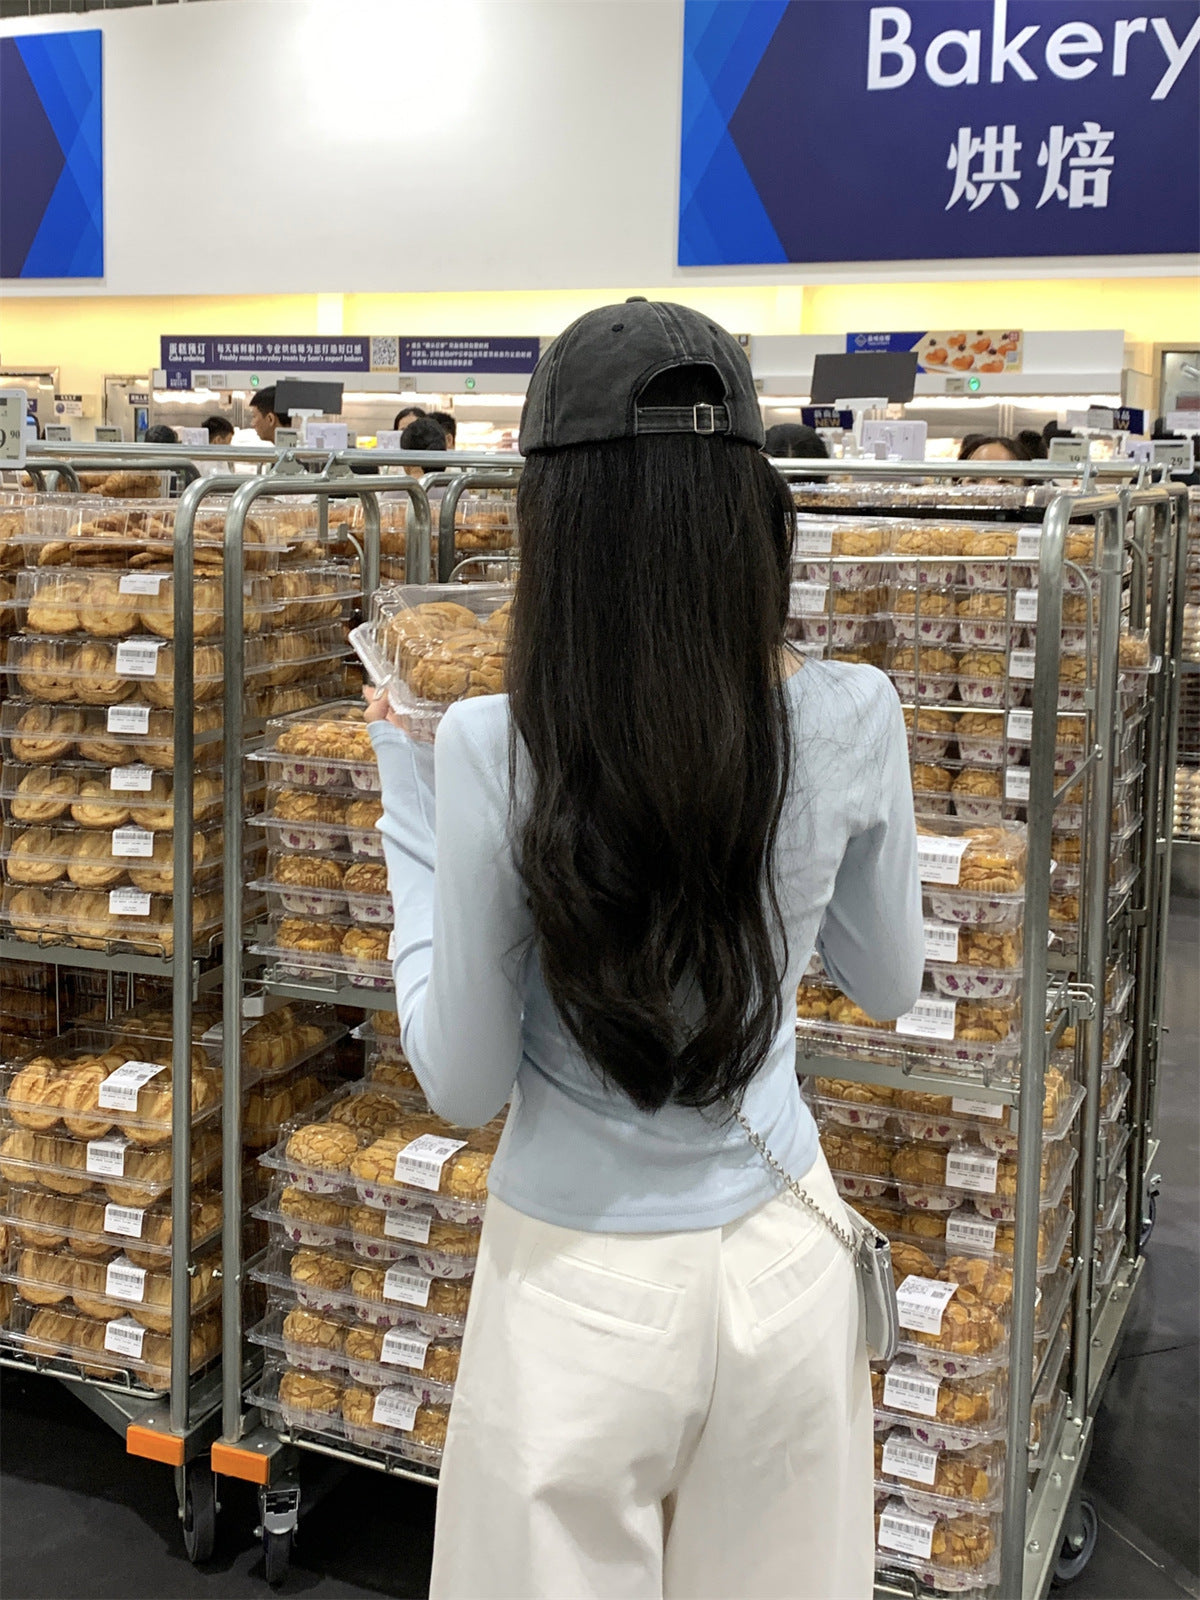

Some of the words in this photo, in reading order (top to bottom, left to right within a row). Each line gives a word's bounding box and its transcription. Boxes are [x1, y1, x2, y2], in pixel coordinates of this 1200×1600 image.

[867, 0, 1200, 101] Bakery
[945, 121, 1116, 212] 烘焙
[169, 343, 206, 354] 蛋糕预订
[168, 354, 182, 362] Cake
[183, 355, 205, 363] ordering
[219, 354, 238, 363] Freshly
[256, 355, 282, 364] everyday
[282, 354, 299, 362] treats
[299, 354, 307, 363] by
[307, 354, 324, 362] Sam's
[343, 354, 364, 362] bakers
[815, 418, 841, 427] NEW
